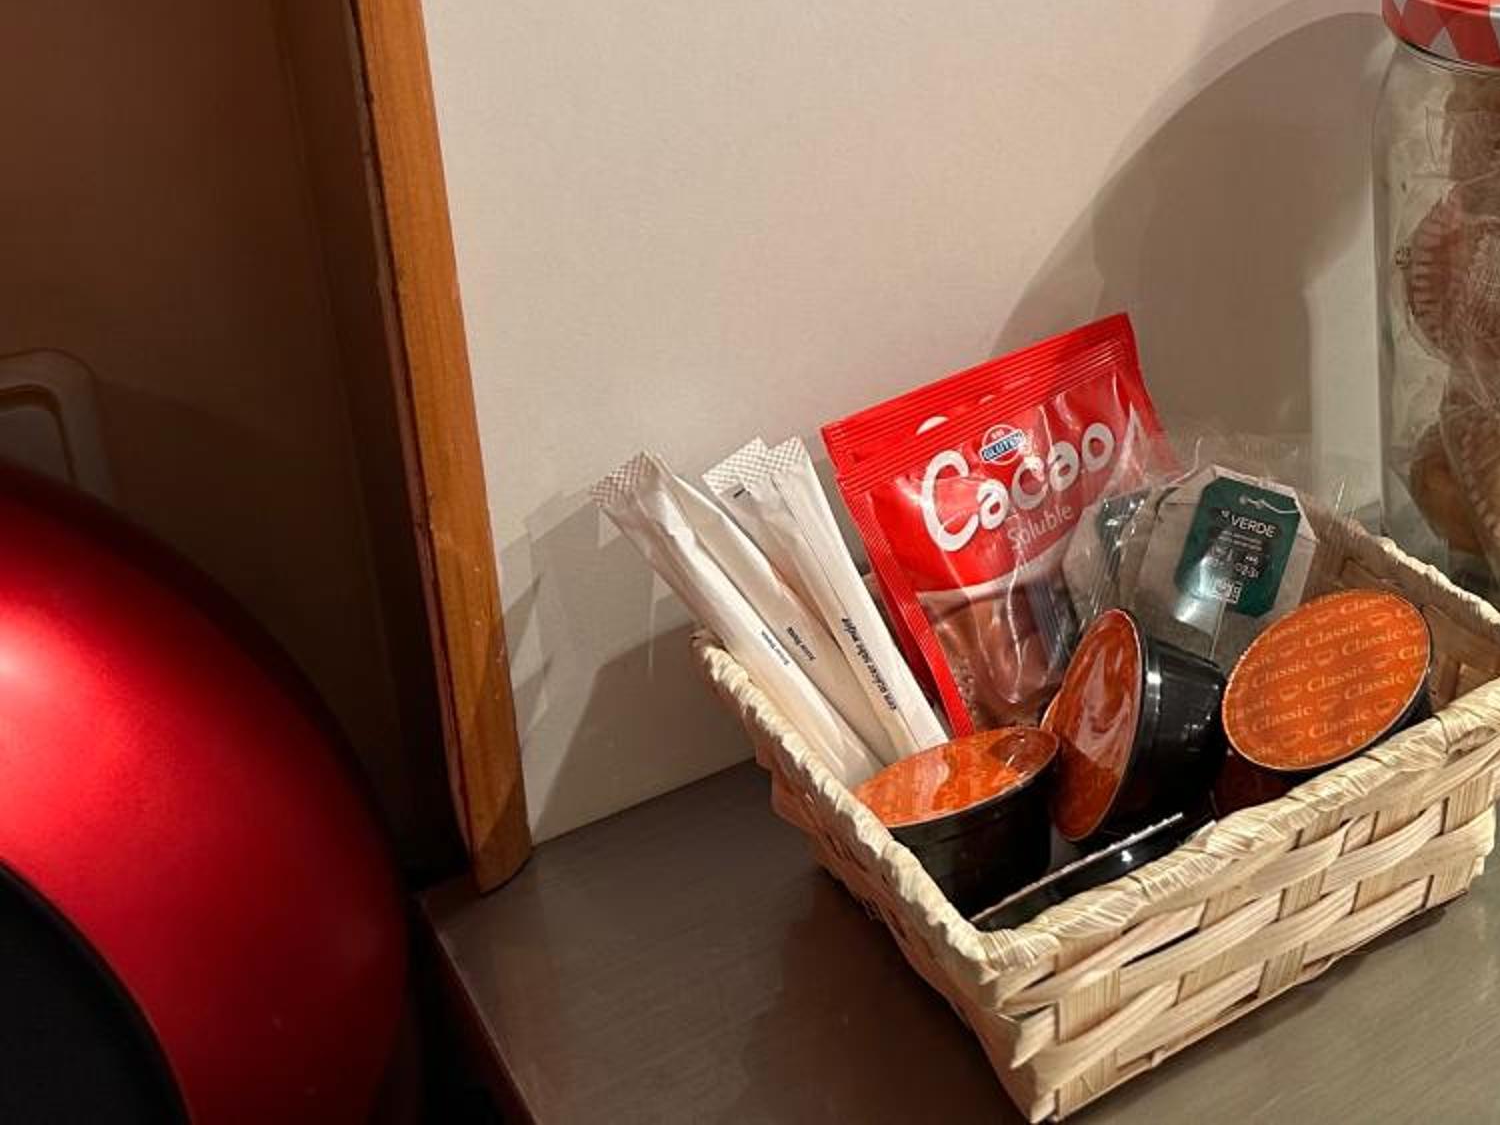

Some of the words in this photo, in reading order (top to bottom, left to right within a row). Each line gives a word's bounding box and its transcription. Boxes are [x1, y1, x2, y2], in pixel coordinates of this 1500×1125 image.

[920, 422, 1115, 551] Cacao
[1008, 505, 1073, 548] Soluble
[1231, 515, 1277, 538] VERDE
[1341, 629, 1402, 655] Classic
[1306, 665, 1366, 691] Classic
[1344, 674, 1406, 700] Classic
[1252, 704, 1313, 732] Classic
[1309, 711, 1372, 738] Classic
